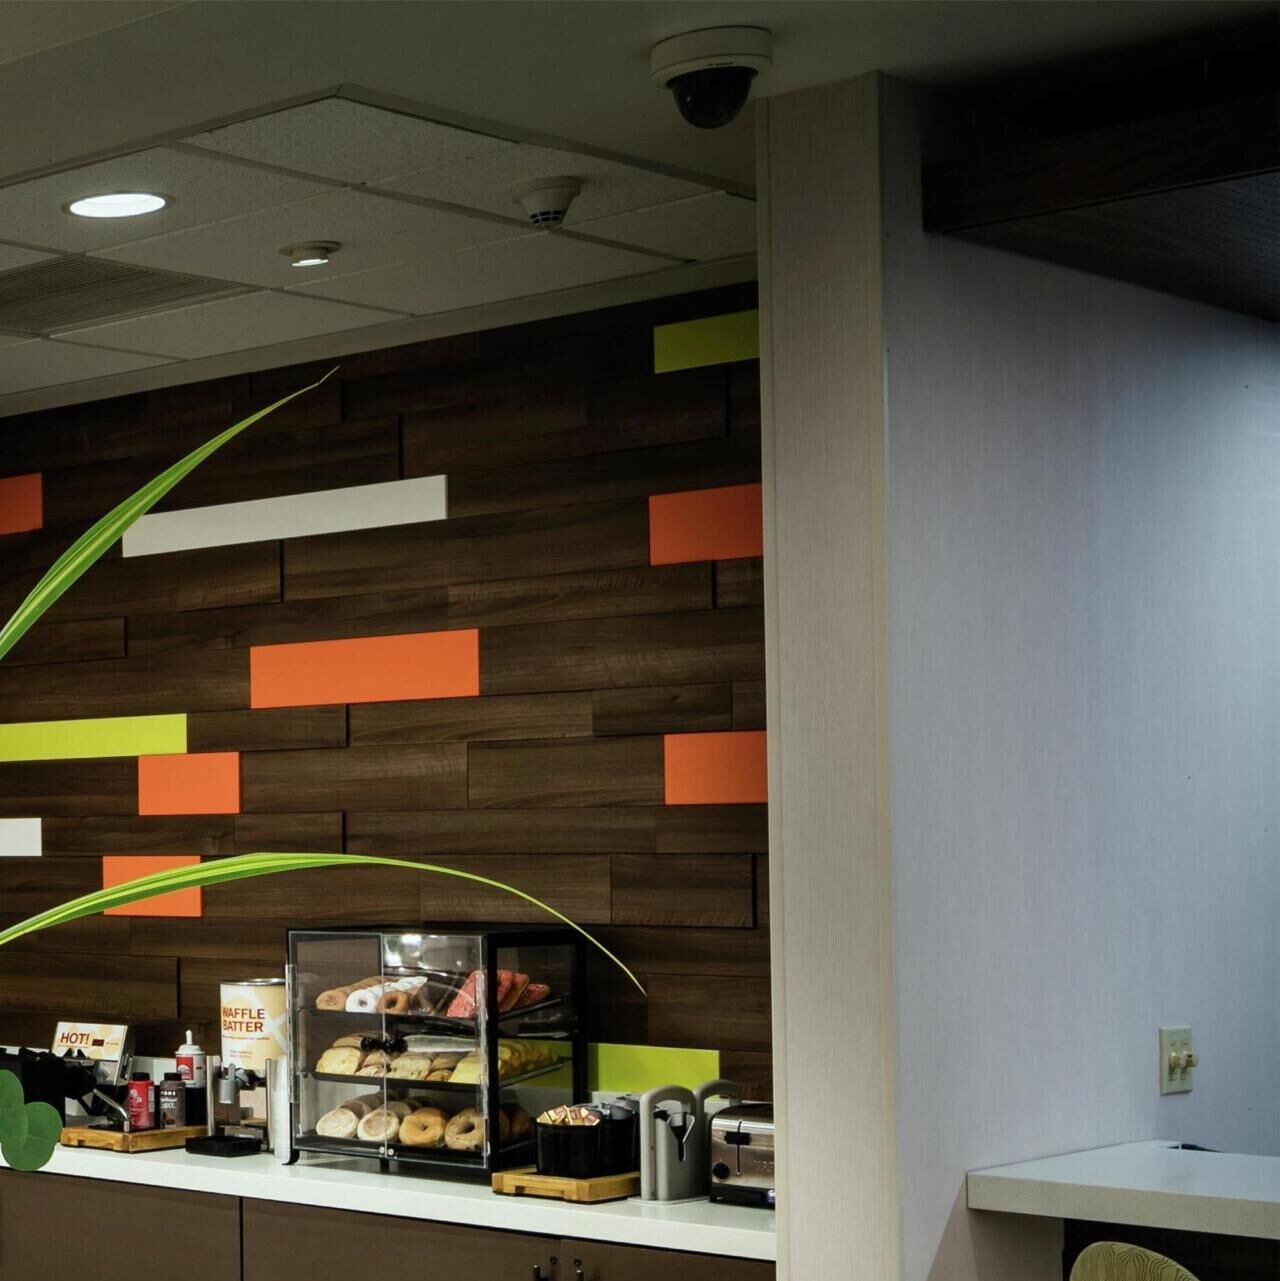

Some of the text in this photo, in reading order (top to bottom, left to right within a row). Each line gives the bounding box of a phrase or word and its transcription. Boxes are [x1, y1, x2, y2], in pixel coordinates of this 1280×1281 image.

[222, 1007, 265, 1020] WAFFLE
[223, 1020, 264, 1033] BATTER
[60, 1032, 90, 1045] HOT!
